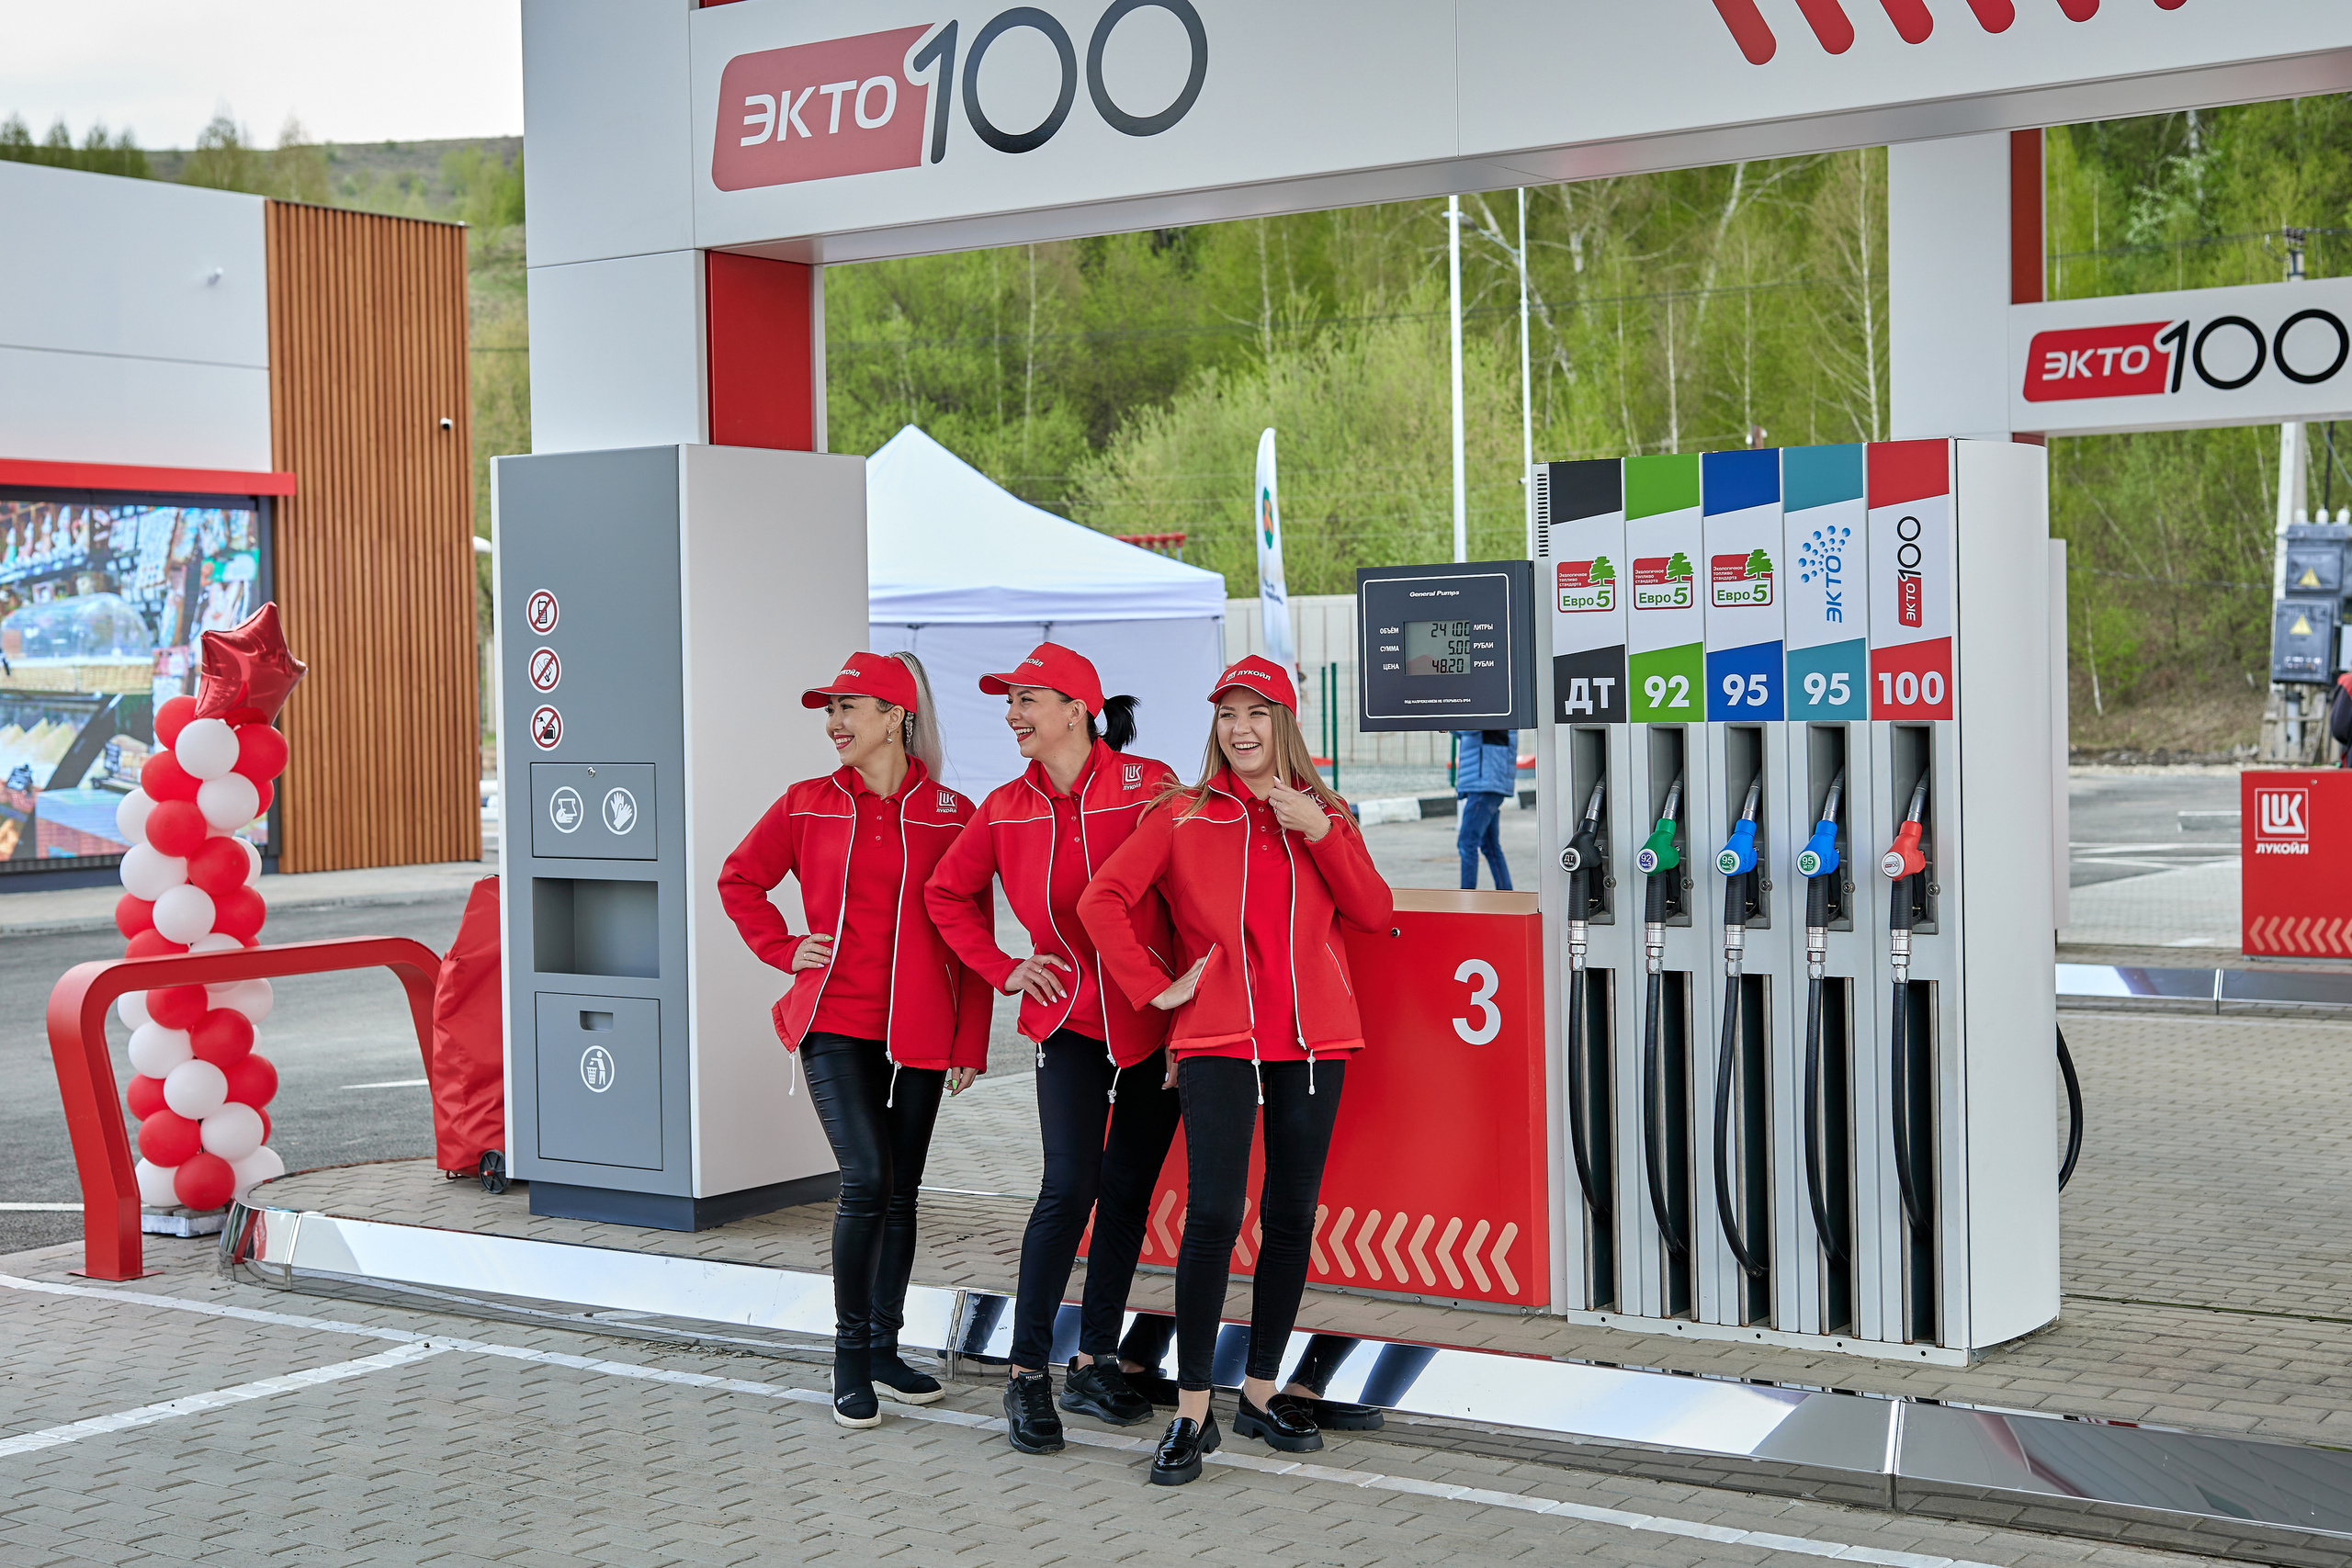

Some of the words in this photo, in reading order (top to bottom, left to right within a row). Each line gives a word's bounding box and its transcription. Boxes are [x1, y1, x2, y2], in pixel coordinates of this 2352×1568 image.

[740, 75, 897, 147] ЭКТО
[913, 0, 1208, 164] 100
[2042, 345, 2150, 380] ЭКТО
[2160, 309, 2350, 393] 100
[1639, 592, 1670, 604] Евро
[1673, 587, 1688, 604] 5
[1717, 590, 1750, 603] Евро
[1752, 584, 1768, 602] 5
[1826, 555, 1842, 623] ЭКТО
[1563, 596, 1594, 608] Евро
[1596, 590, 1611, 607] 5
[1905, 583, 1916, 621] ЭКТО
[1379, 626, 1399, 635] ОБЪЁМ
[1237, 670, 1271, 681] ЛУКОЙЛ
[1432, 659, 1464, 673] 48.20
[1565, 677, 1615, 715] ДТ
[1644, 674, 1690, 708] 92
[1723, 673, 1769, 706] 95
[1804, 671, 1850, 705] 95
[1878, 671, 1945, 705] 100
[2256, 841, 2309, 854] ЛУКОЙЛ
[1564, 854, 1574, 863] ДТ
[1641, 854, 1651, 863] 92
[1722, 856, 1734, 864] 95
[1802, 856, 1814, 865] 95
[1452, 959, 1501, 1045] 3
